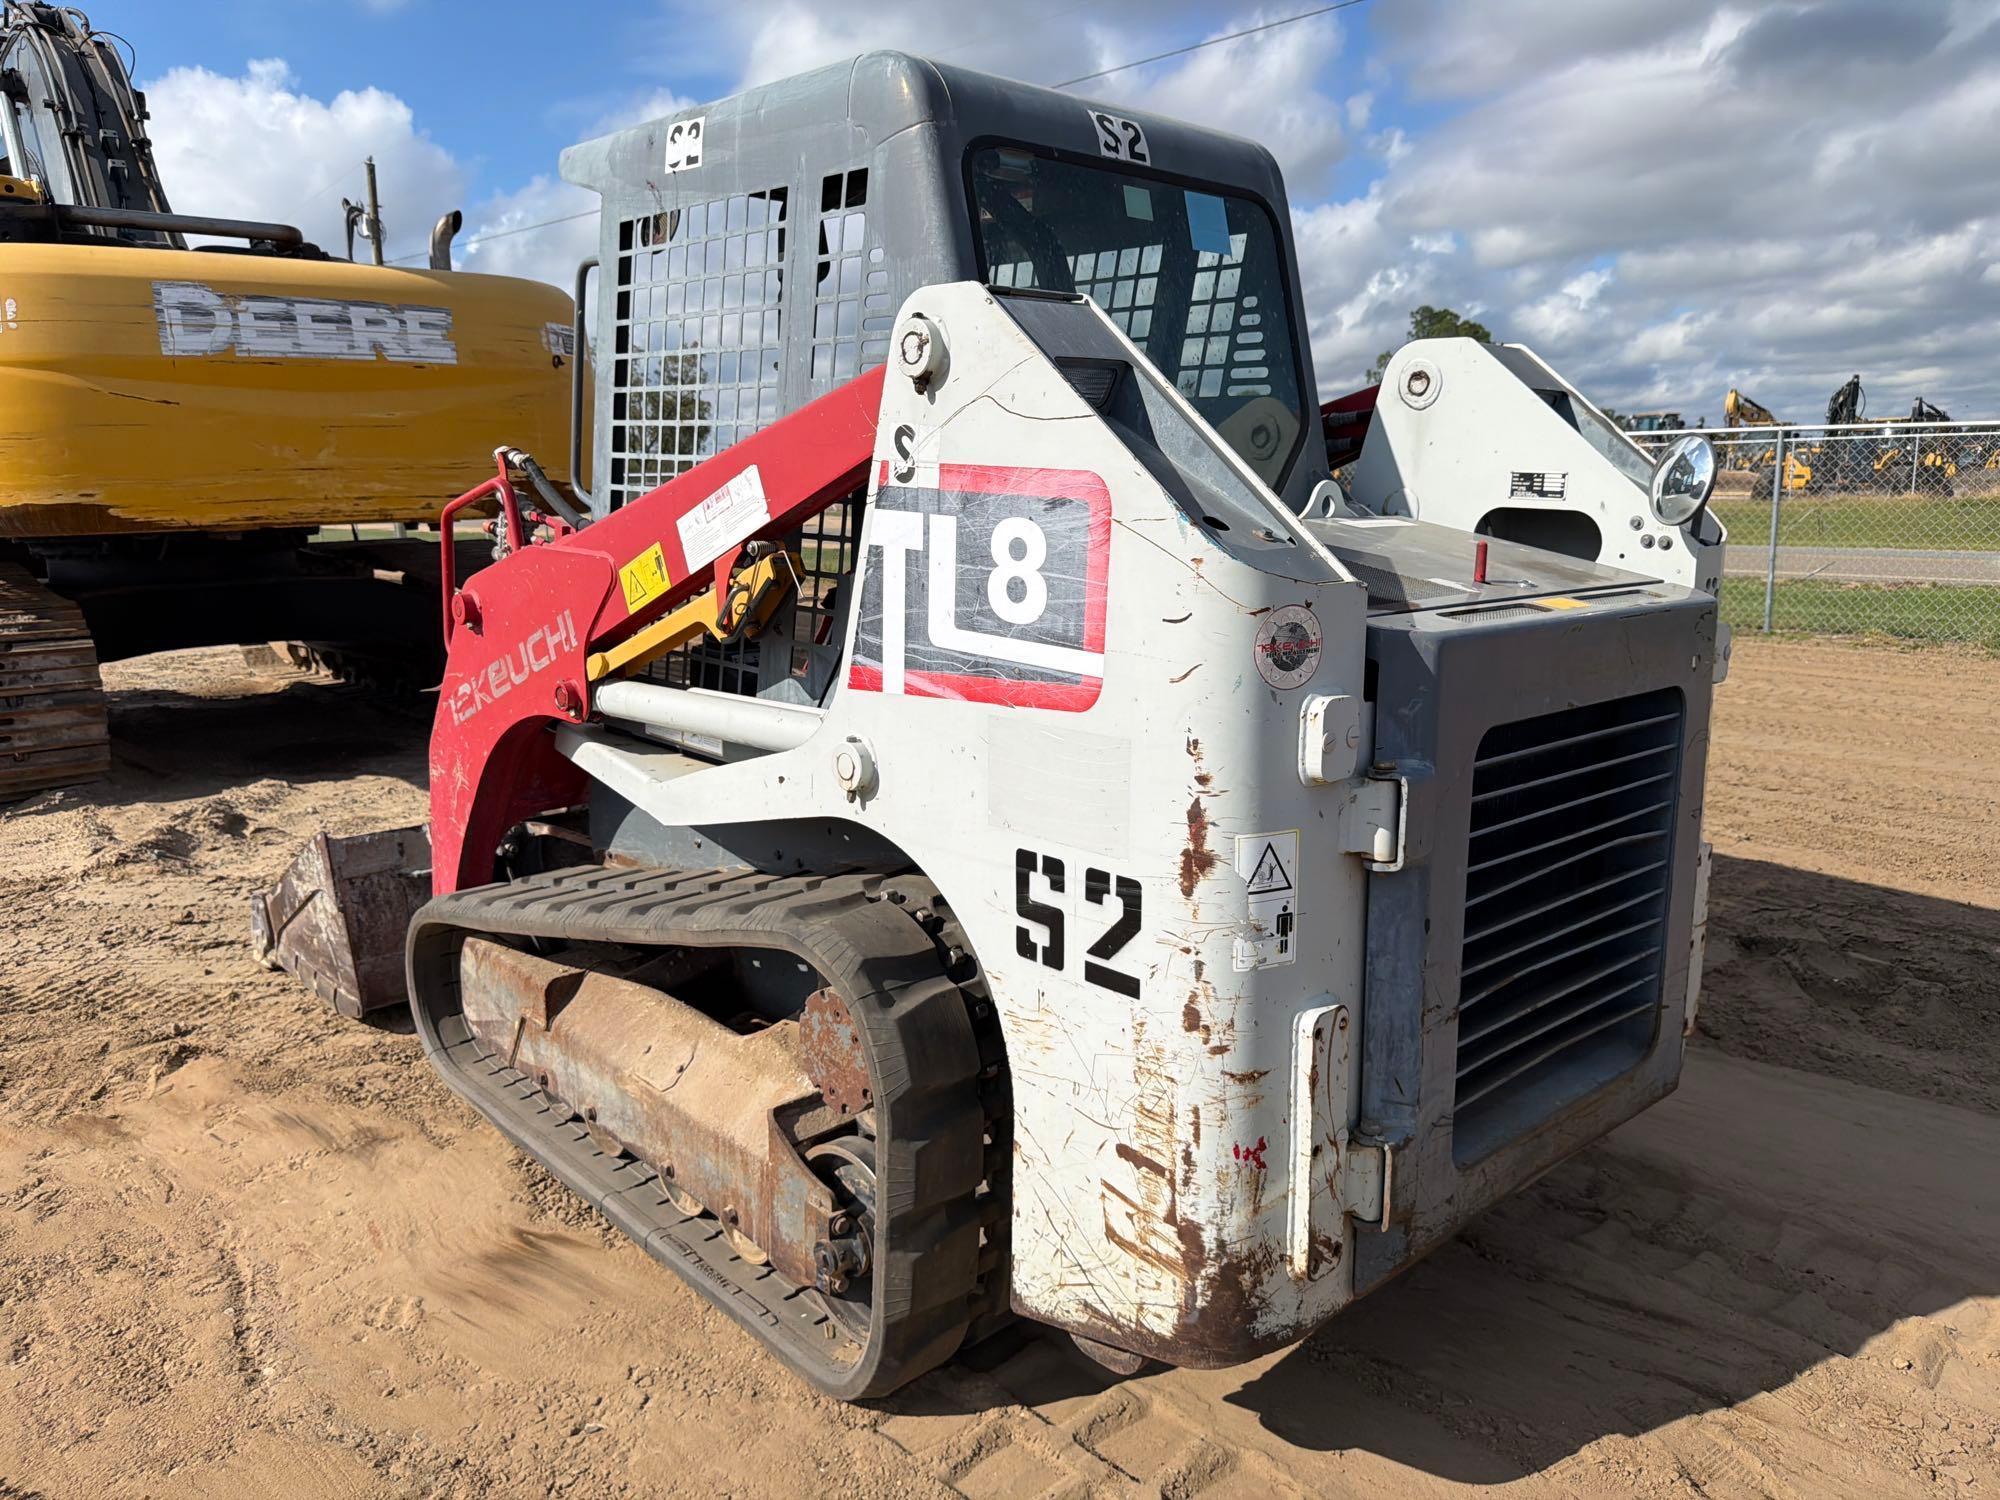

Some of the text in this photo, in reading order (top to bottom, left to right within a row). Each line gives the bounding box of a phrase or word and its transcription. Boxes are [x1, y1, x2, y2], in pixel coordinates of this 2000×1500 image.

[668, 122, 700, 168] S2
[1096, 114, 1147, 162] S2
[161, 285, 457, 364] DEERE
[893, 424, 915, 484] S
[868, 508, 1104, 695] TL8
[1016, 848, 1142, 1000] S2
